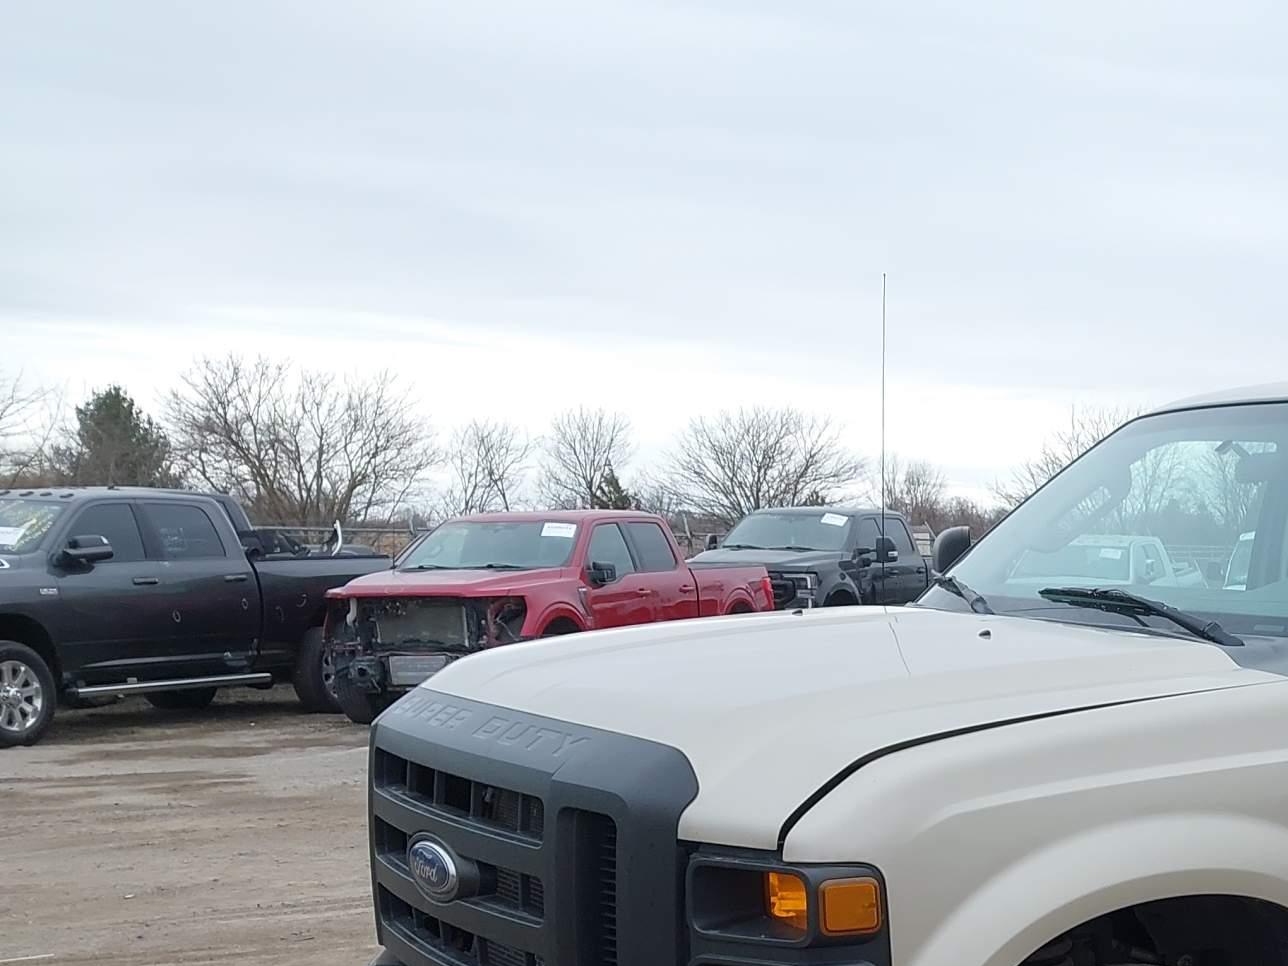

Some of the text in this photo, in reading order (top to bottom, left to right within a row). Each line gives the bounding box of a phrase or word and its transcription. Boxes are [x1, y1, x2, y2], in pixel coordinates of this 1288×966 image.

[392, 697, 592, 757] SUPER DUTY
[413, 848, 438, 883] Ford
